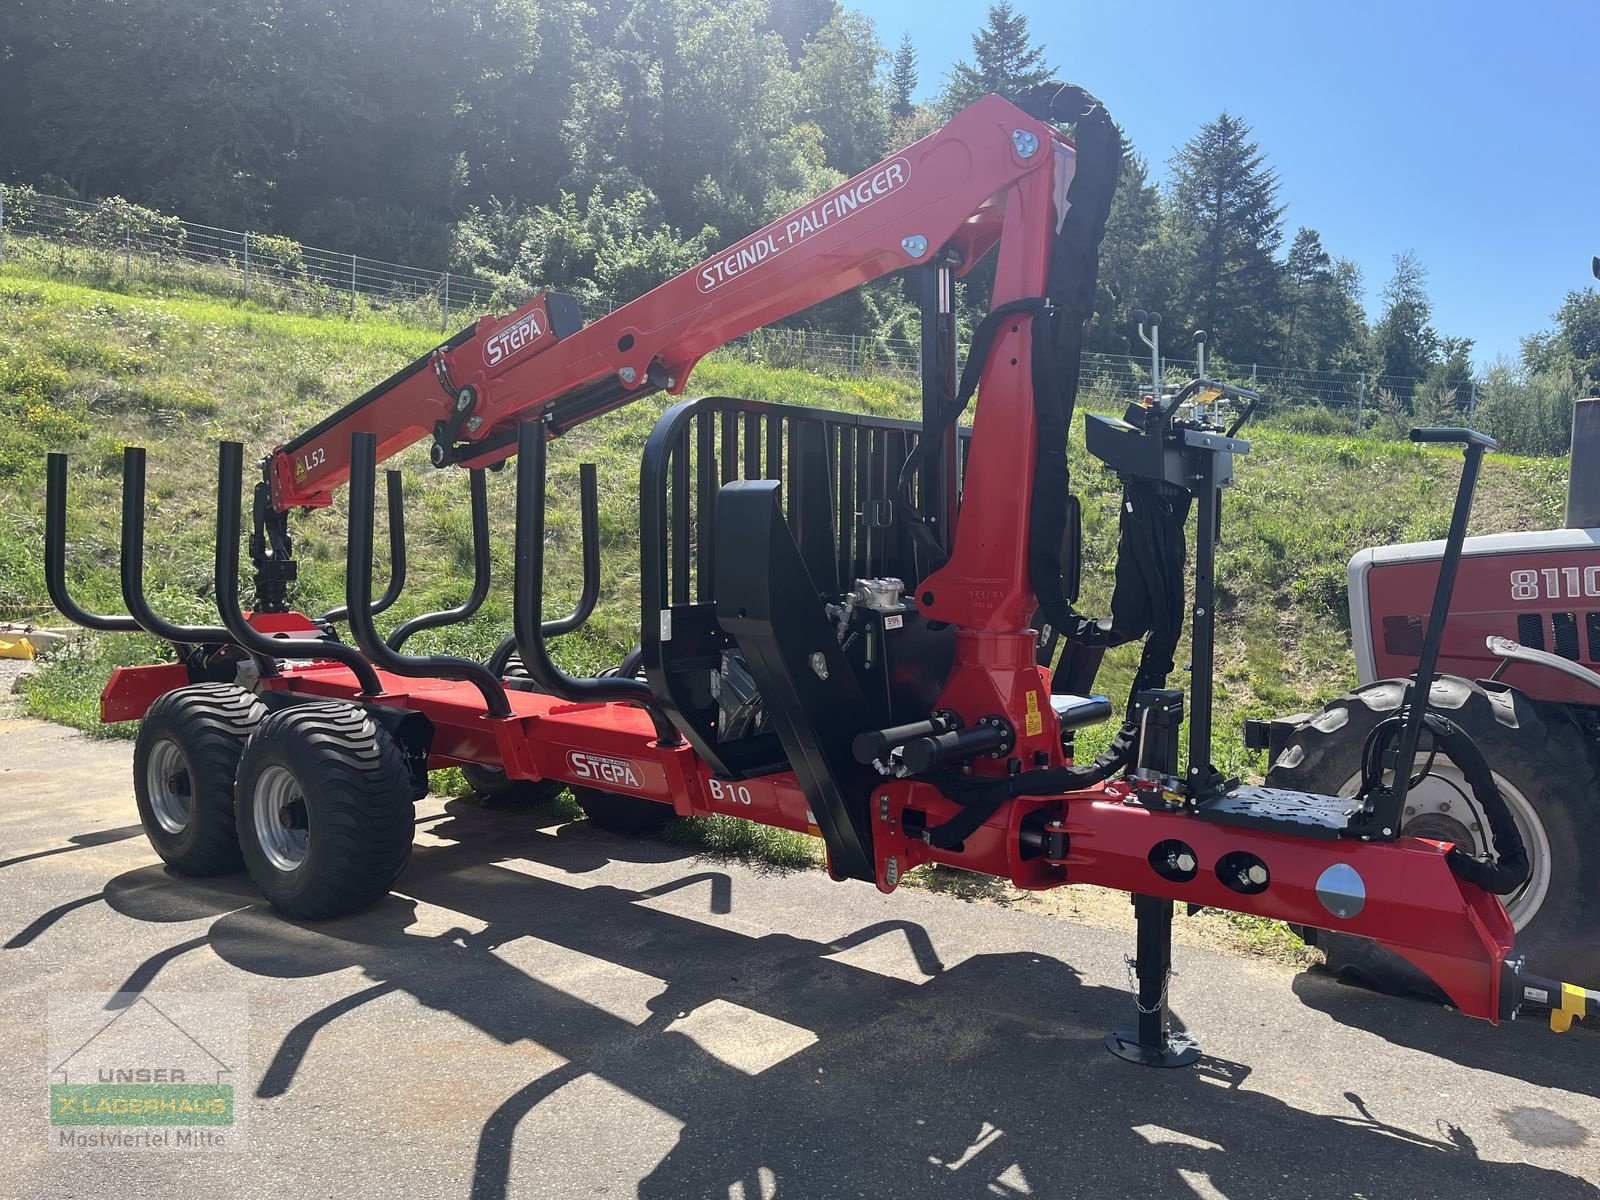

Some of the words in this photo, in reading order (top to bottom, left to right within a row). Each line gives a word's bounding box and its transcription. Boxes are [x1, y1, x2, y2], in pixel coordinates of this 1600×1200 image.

[702, 163, 904, 290] STEINDL-PALFINGER
[487, 319, 542, 365] STEPA
[304, 447, 326, 471] L52
[571, 752, 640, 787] STEPA
[708, 779, 752, 805] B10
